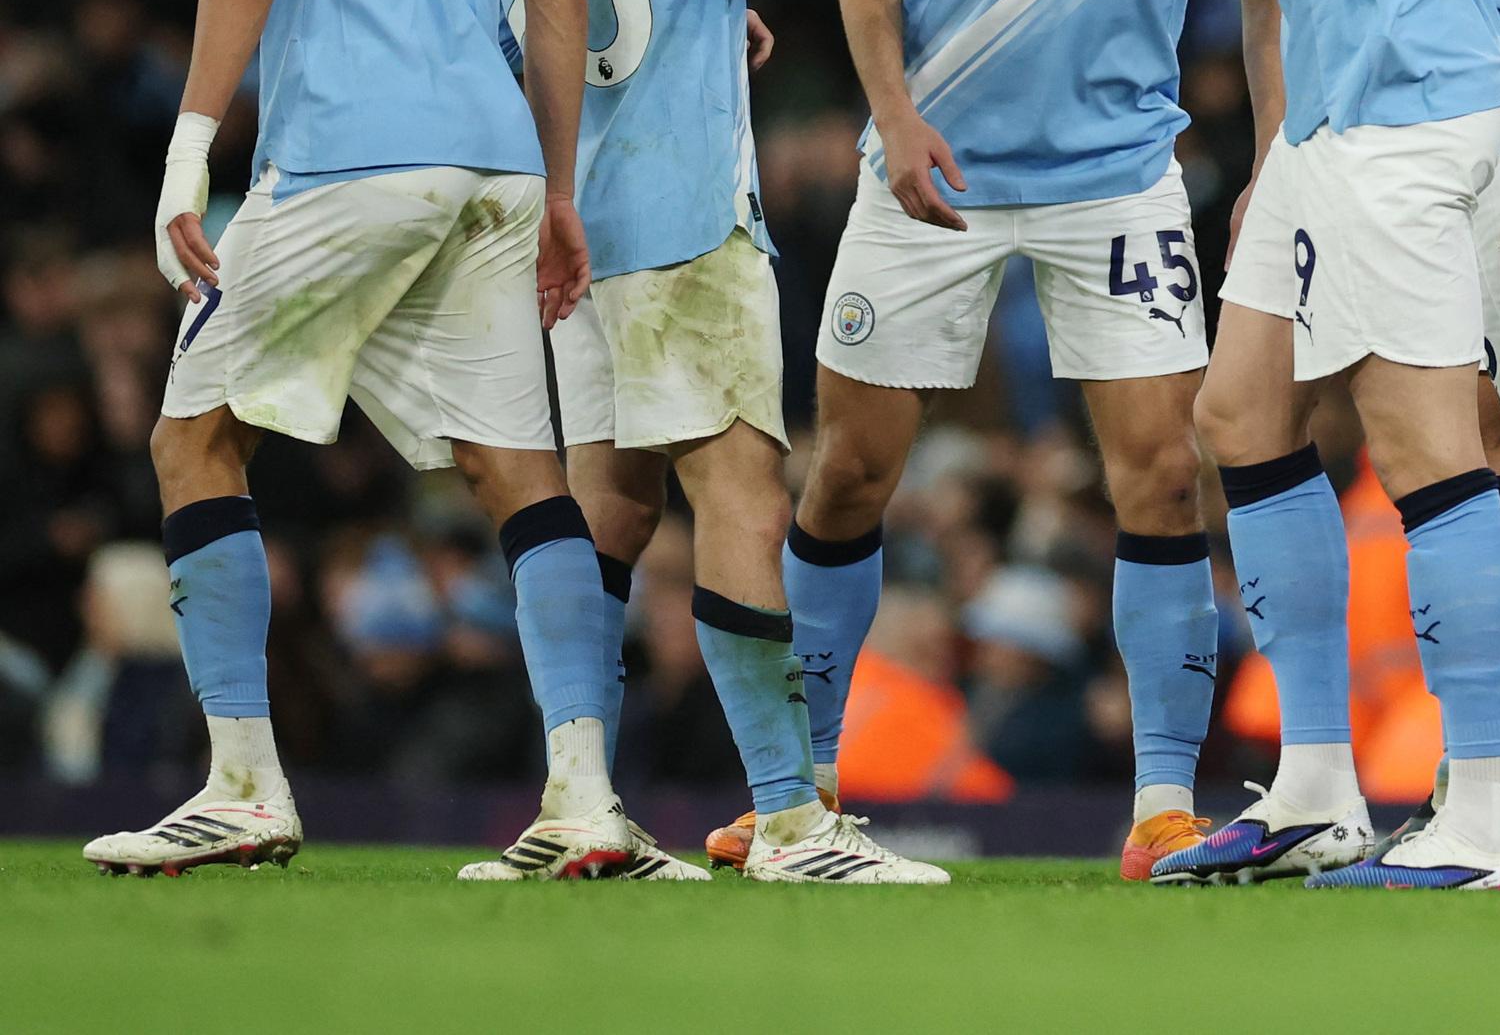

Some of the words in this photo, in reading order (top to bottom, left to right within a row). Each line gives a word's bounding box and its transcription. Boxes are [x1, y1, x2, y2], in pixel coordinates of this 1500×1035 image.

[1109, 230, 1197, 303] 45
[1294, 227, 1316, 306] 9
[179, 276, 223, 352] 7
[1185, 653, 1216, 663] CIT
